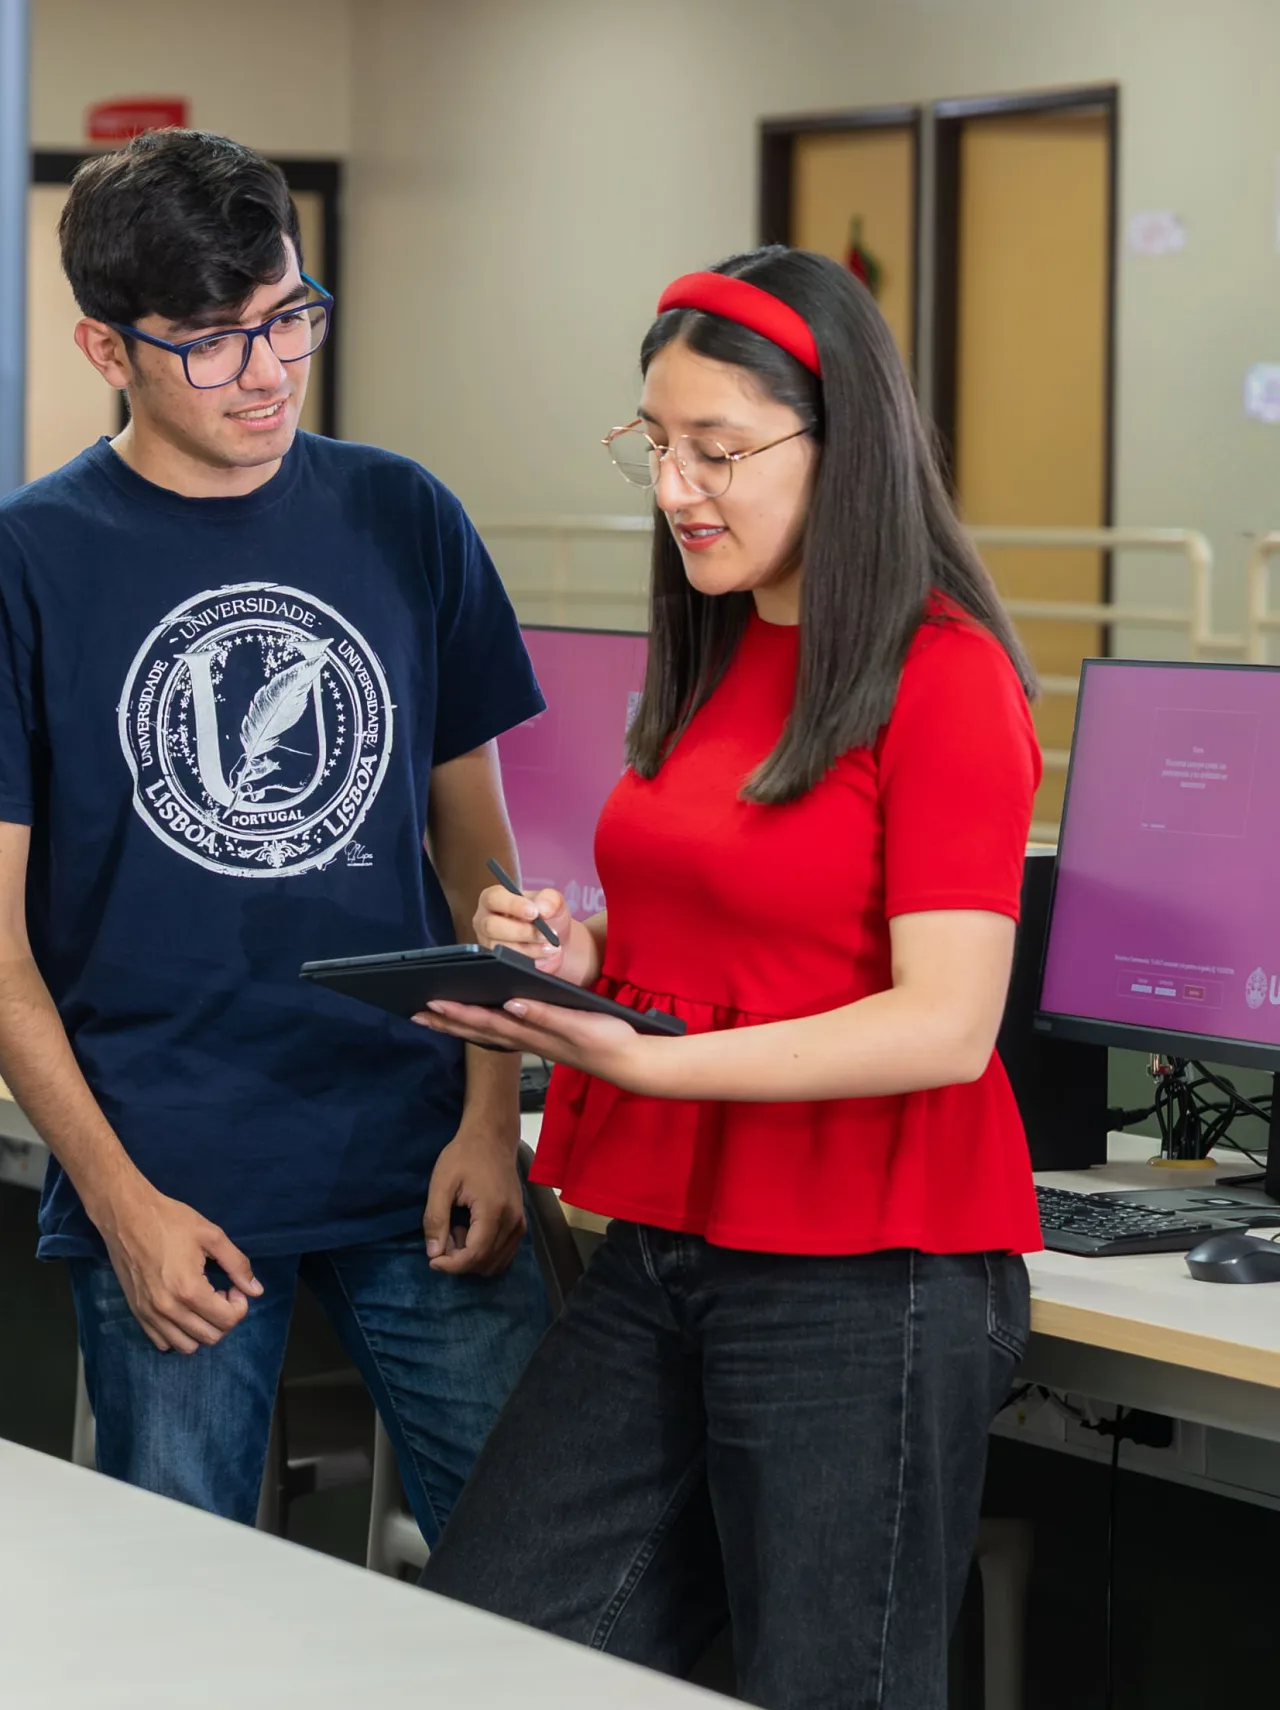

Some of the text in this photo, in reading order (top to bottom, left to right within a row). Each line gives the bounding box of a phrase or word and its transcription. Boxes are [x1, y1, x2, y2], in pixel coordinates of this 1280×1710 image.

[179, 598, 317, 640] UNIVERSIDADE
[137, 659, 169, 768] UNIVERSIDADE
[337, 639, 379, 745] UNIVERSIDADE
[145, 778, 218, 856] LISBOA
[231, 811, 305, 826] PORTUGAL
[322, 753, 378, 837] LISBOA
